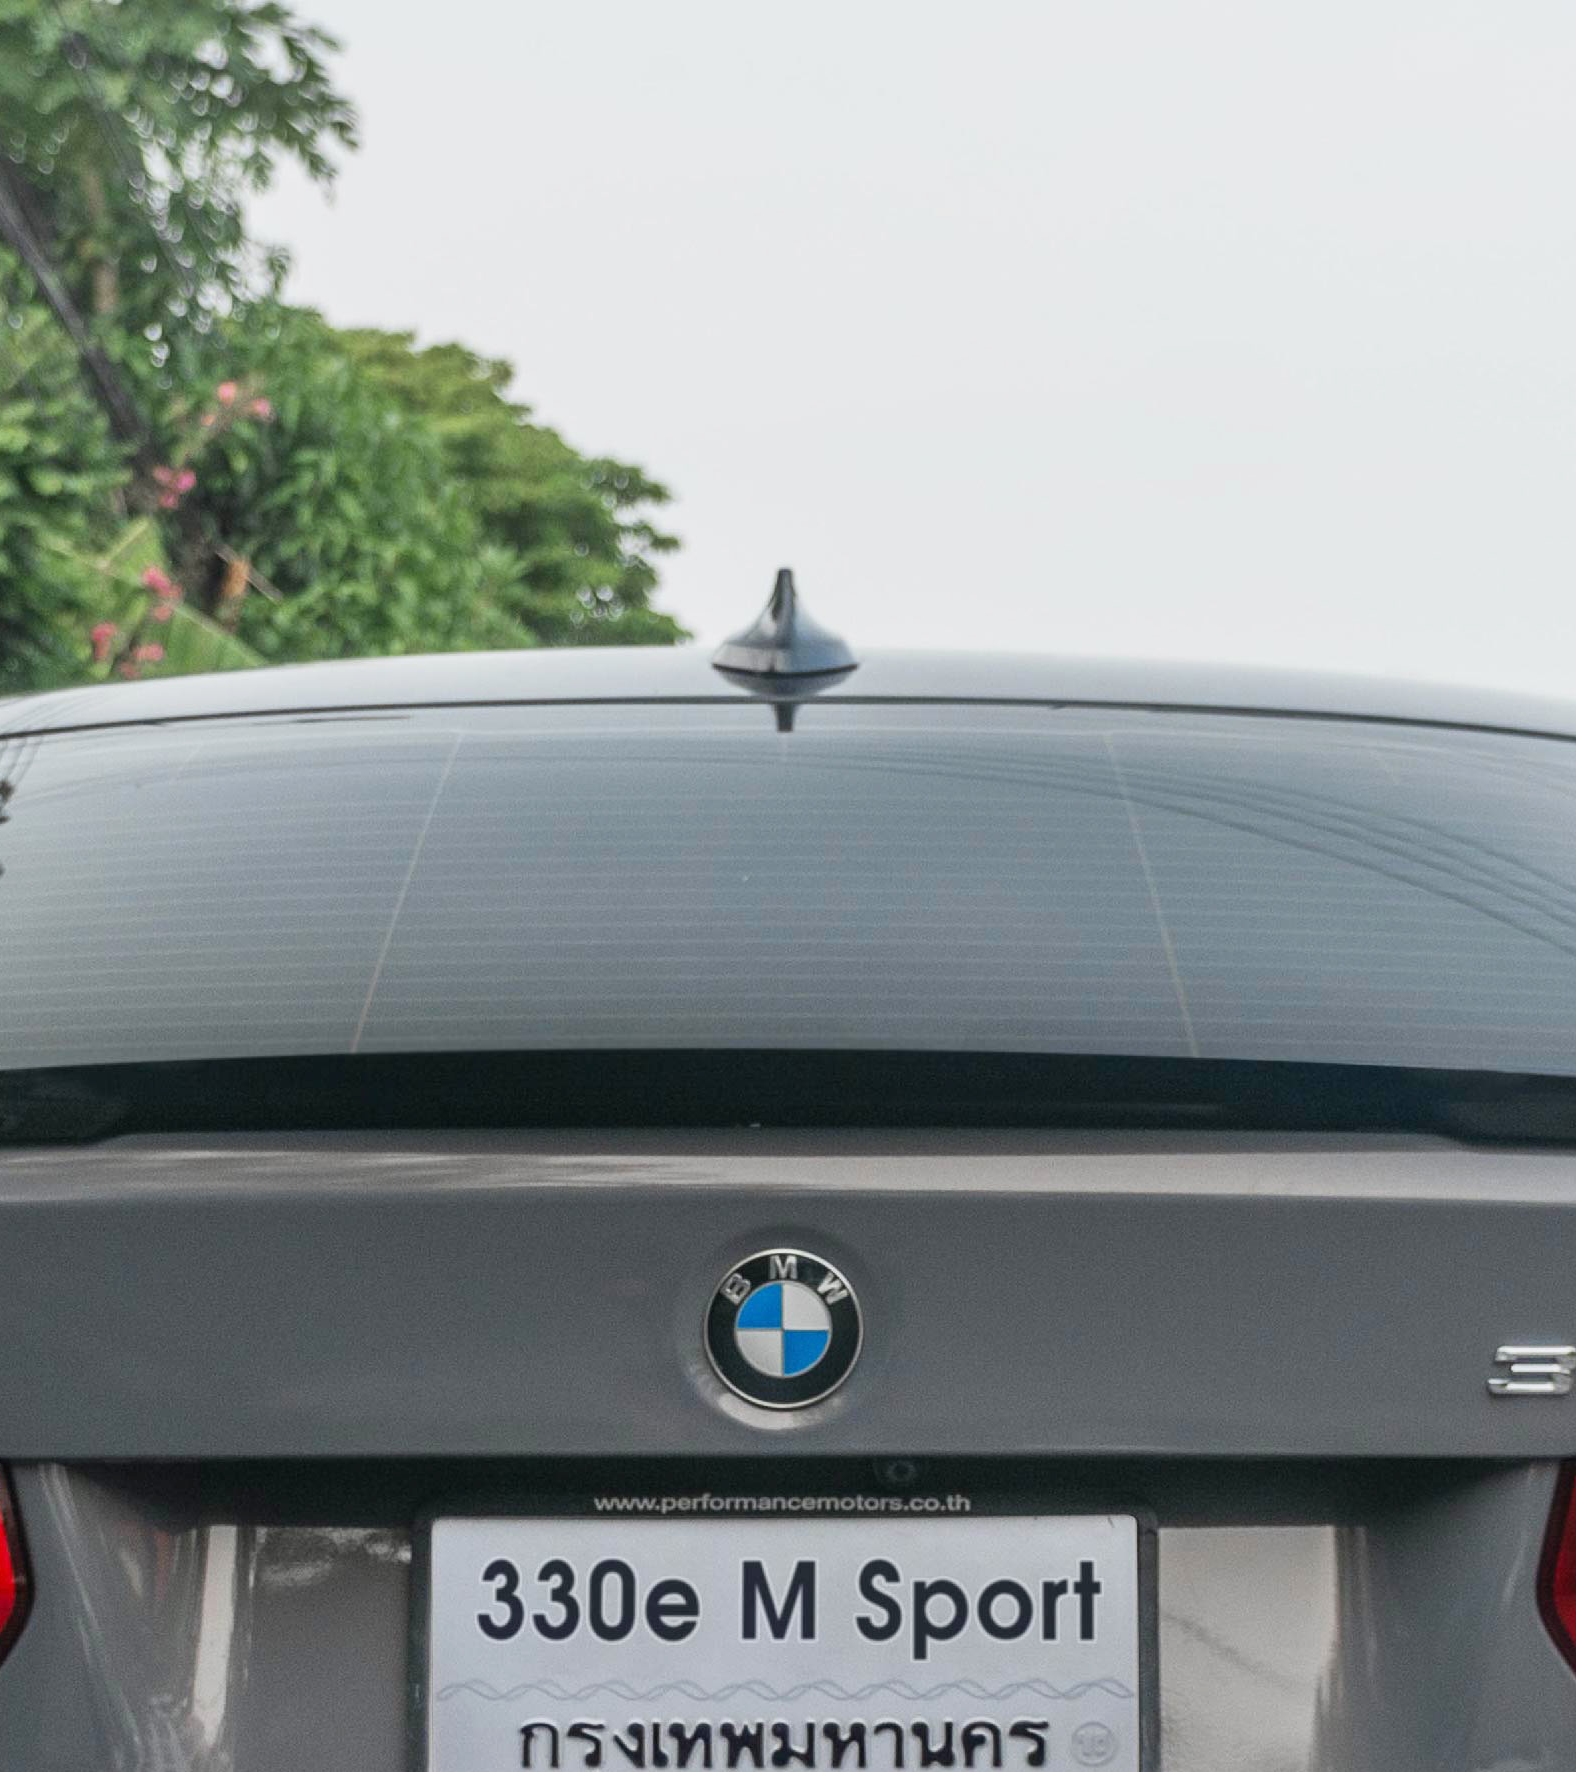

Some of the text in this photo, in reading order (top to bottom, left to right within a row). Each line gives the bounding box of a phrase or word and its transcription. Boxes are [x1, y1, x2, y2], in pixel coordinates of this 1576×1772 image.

[721, 1254, 849, 1305] BMW
[593, 1493, 972, 1514] www.performancemotors.co.th
[477, 1558, 1102, 1661] 330e M Sport
